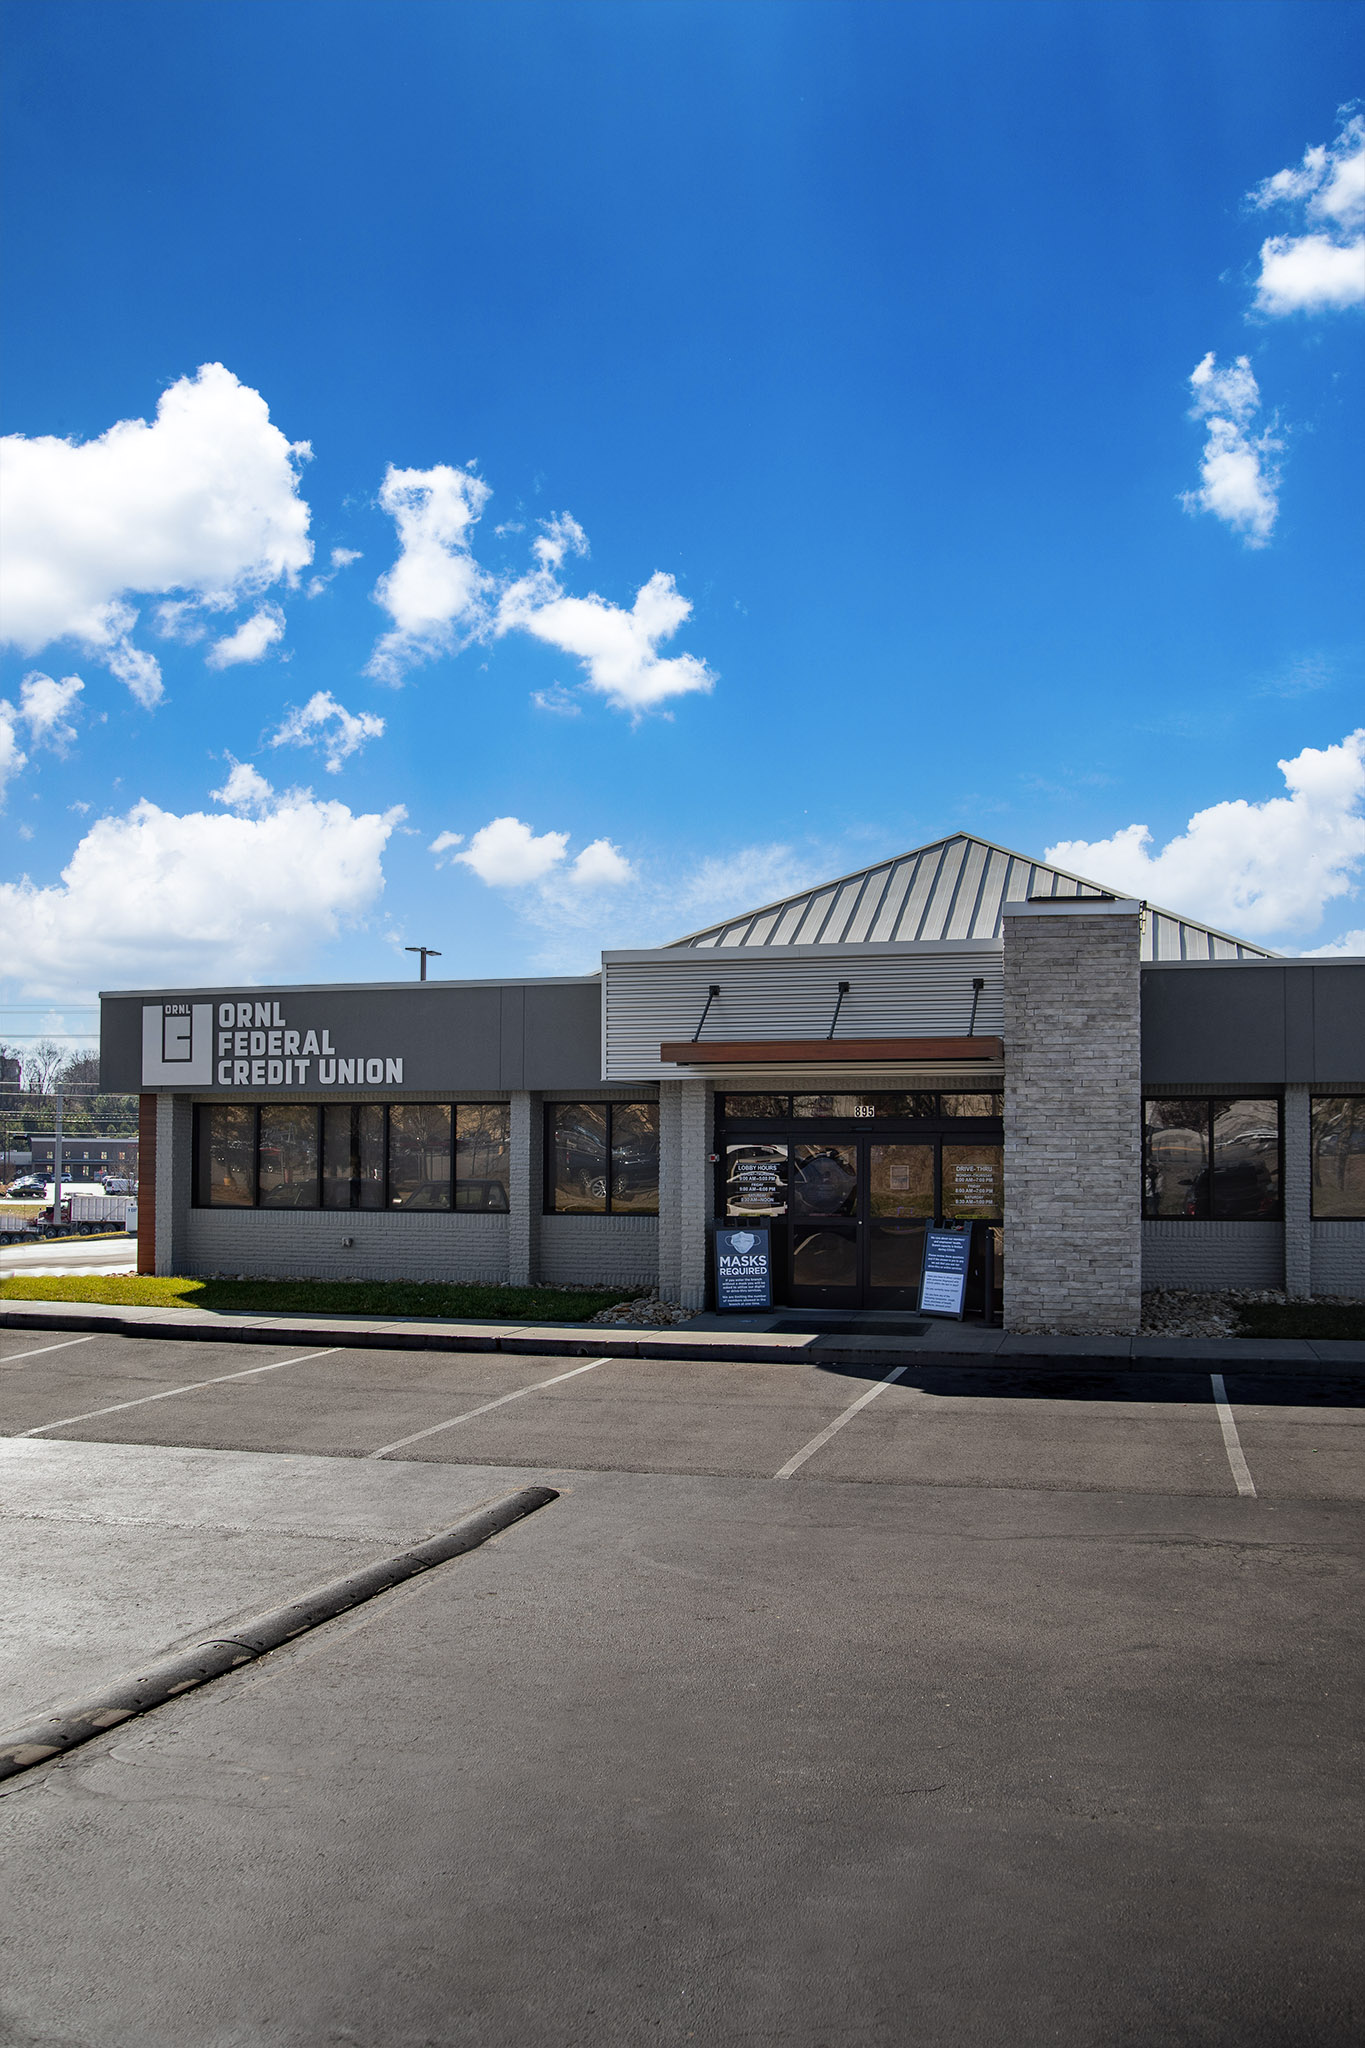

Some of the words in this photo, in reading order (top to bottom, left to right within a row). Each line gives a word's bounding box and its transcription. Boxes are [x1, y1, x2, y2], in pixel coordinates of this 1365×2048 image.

[165, 1005, 190, 1014] ORNL
[219, 1002, 286, 1028] ORNL
[219, 1030, 335, 1056] FEDERAL
[218, 1060, 310, 1085] CREDIT
[319, 1058, 402, 1084] UNION
[855, 1107, 874, 1117] 895
[720, 1256, 767, 1267] MASKS
[720, 1267, 767, 1275] REQUIRED
